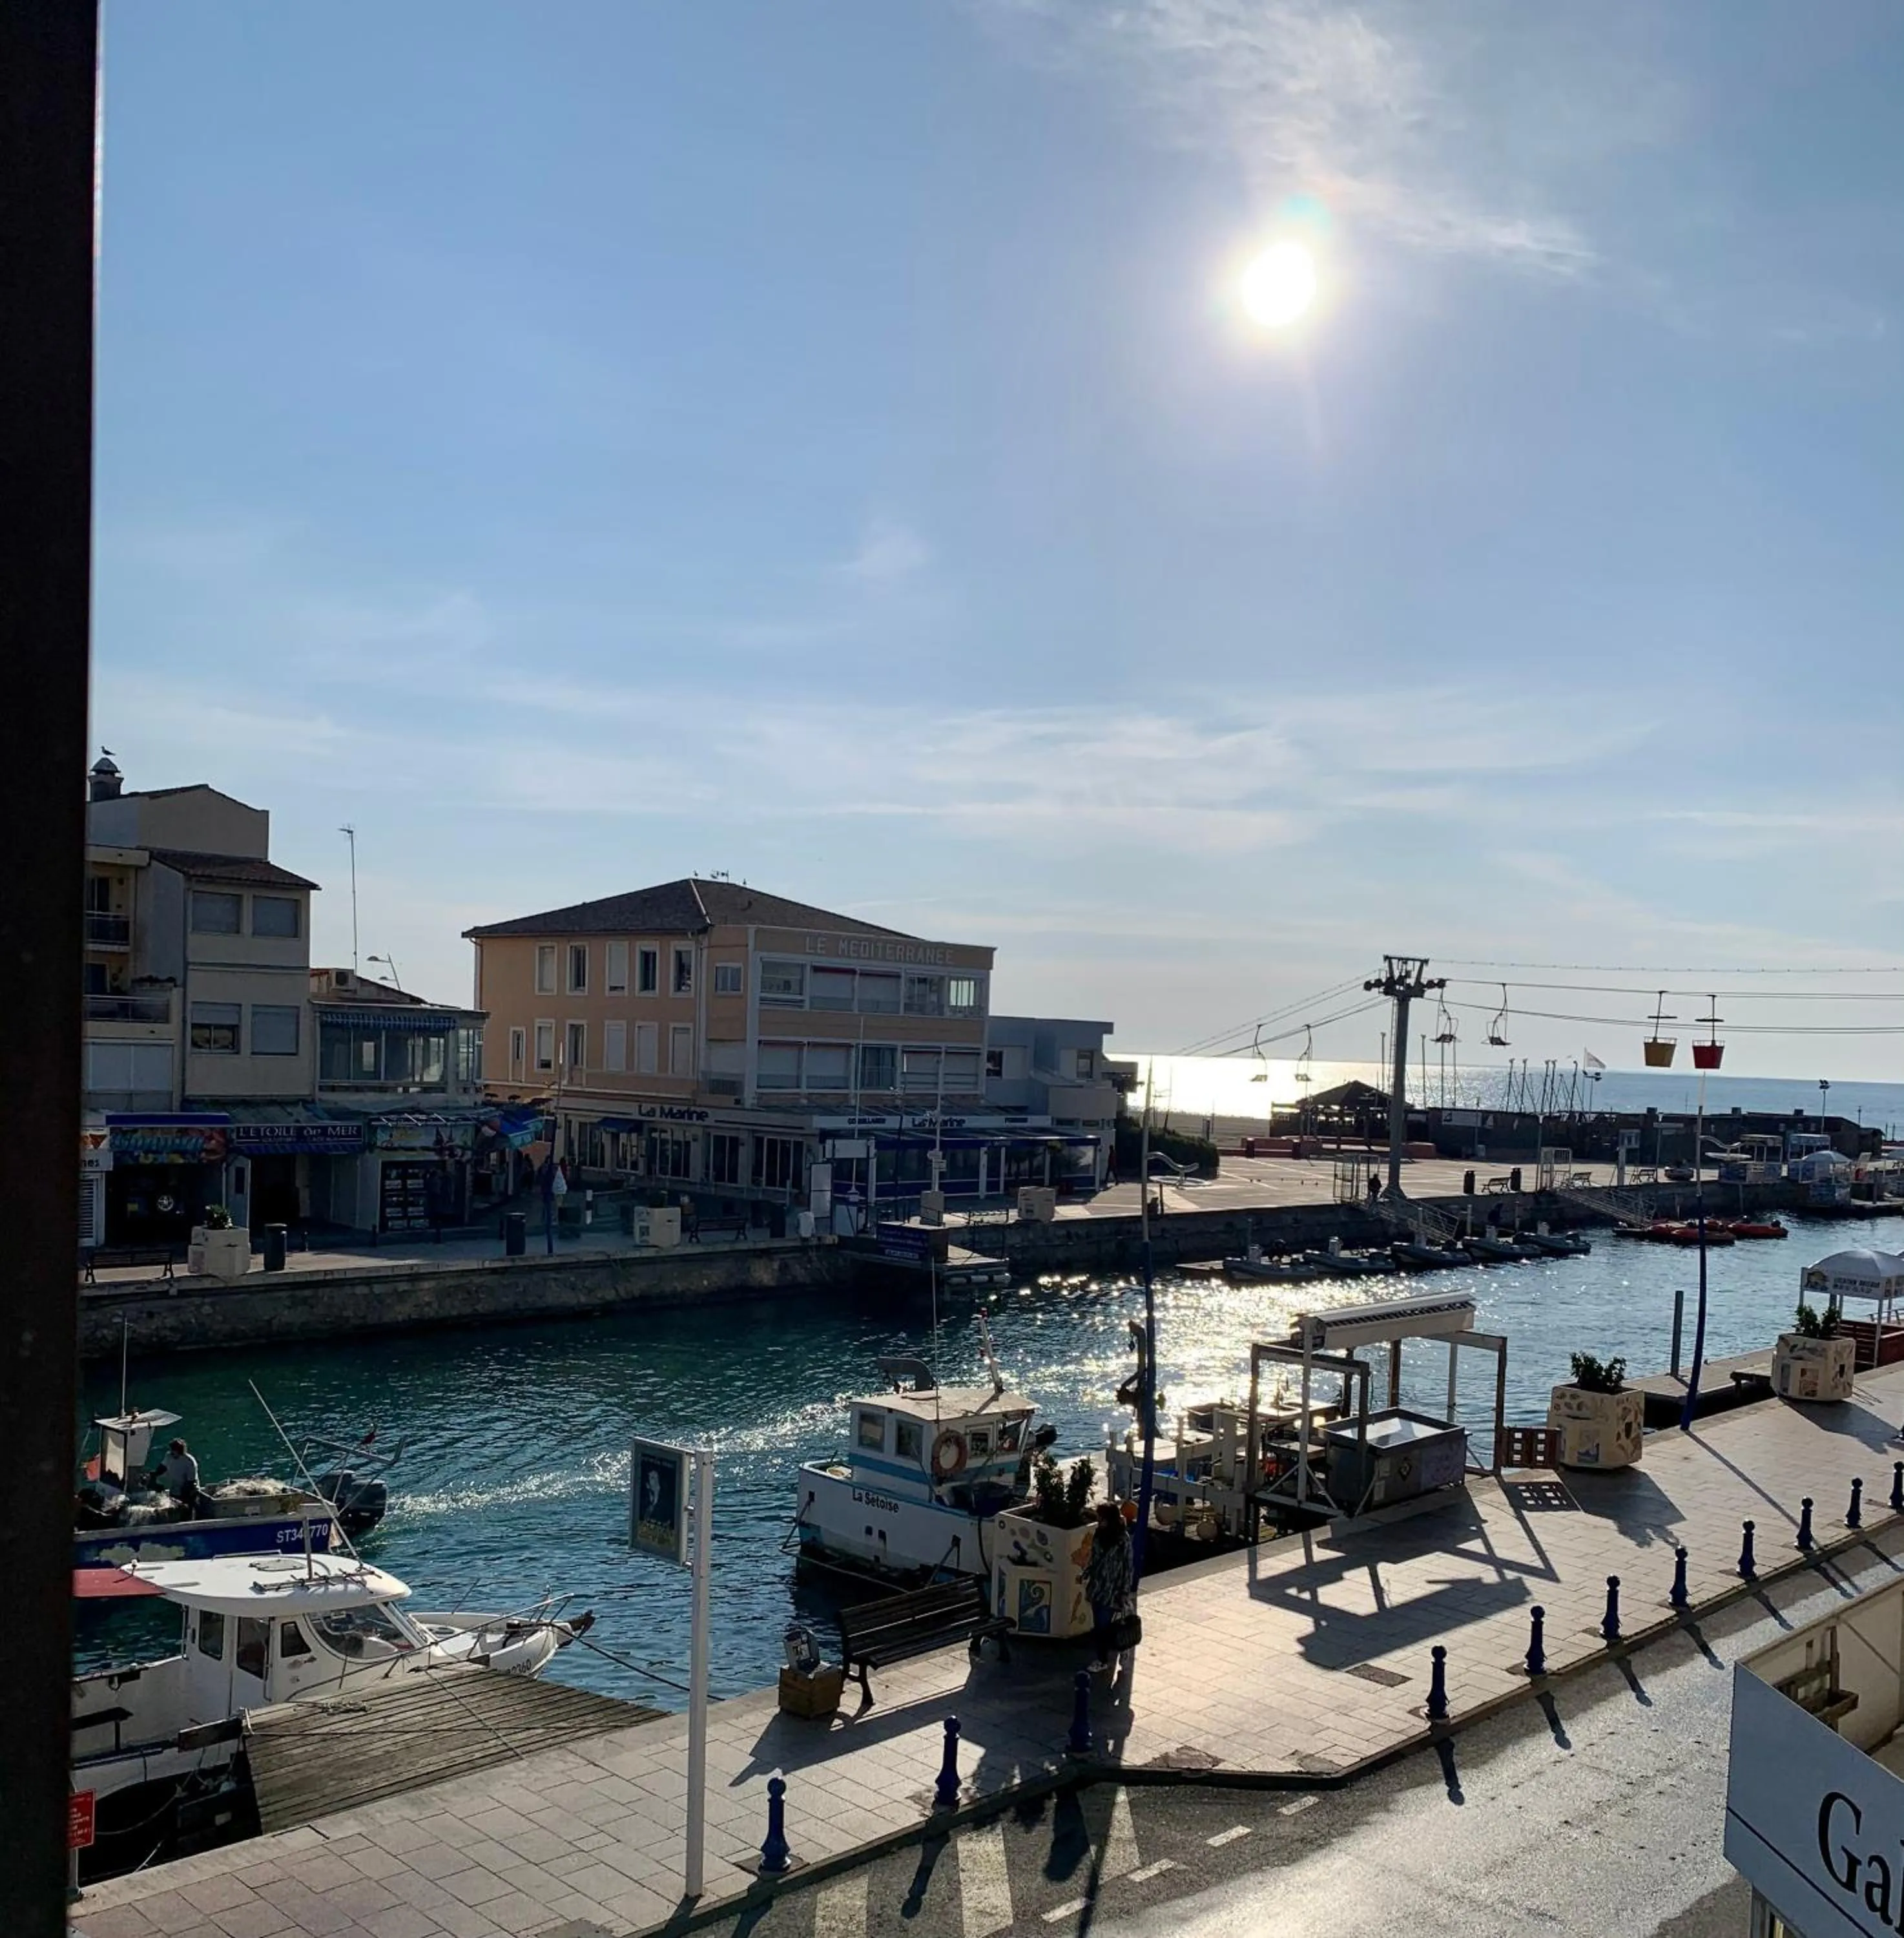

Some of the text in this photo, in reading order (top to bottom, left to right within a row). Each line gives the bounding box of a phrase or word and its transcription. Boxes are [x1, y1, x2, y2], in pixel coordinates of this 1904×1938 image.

[805, 936, 827, 954] LE
[638, 1104, 709, 1122] La Marine
[327, 1126, 357, 1136] MER
[852, 1488, 863, 1502] La
